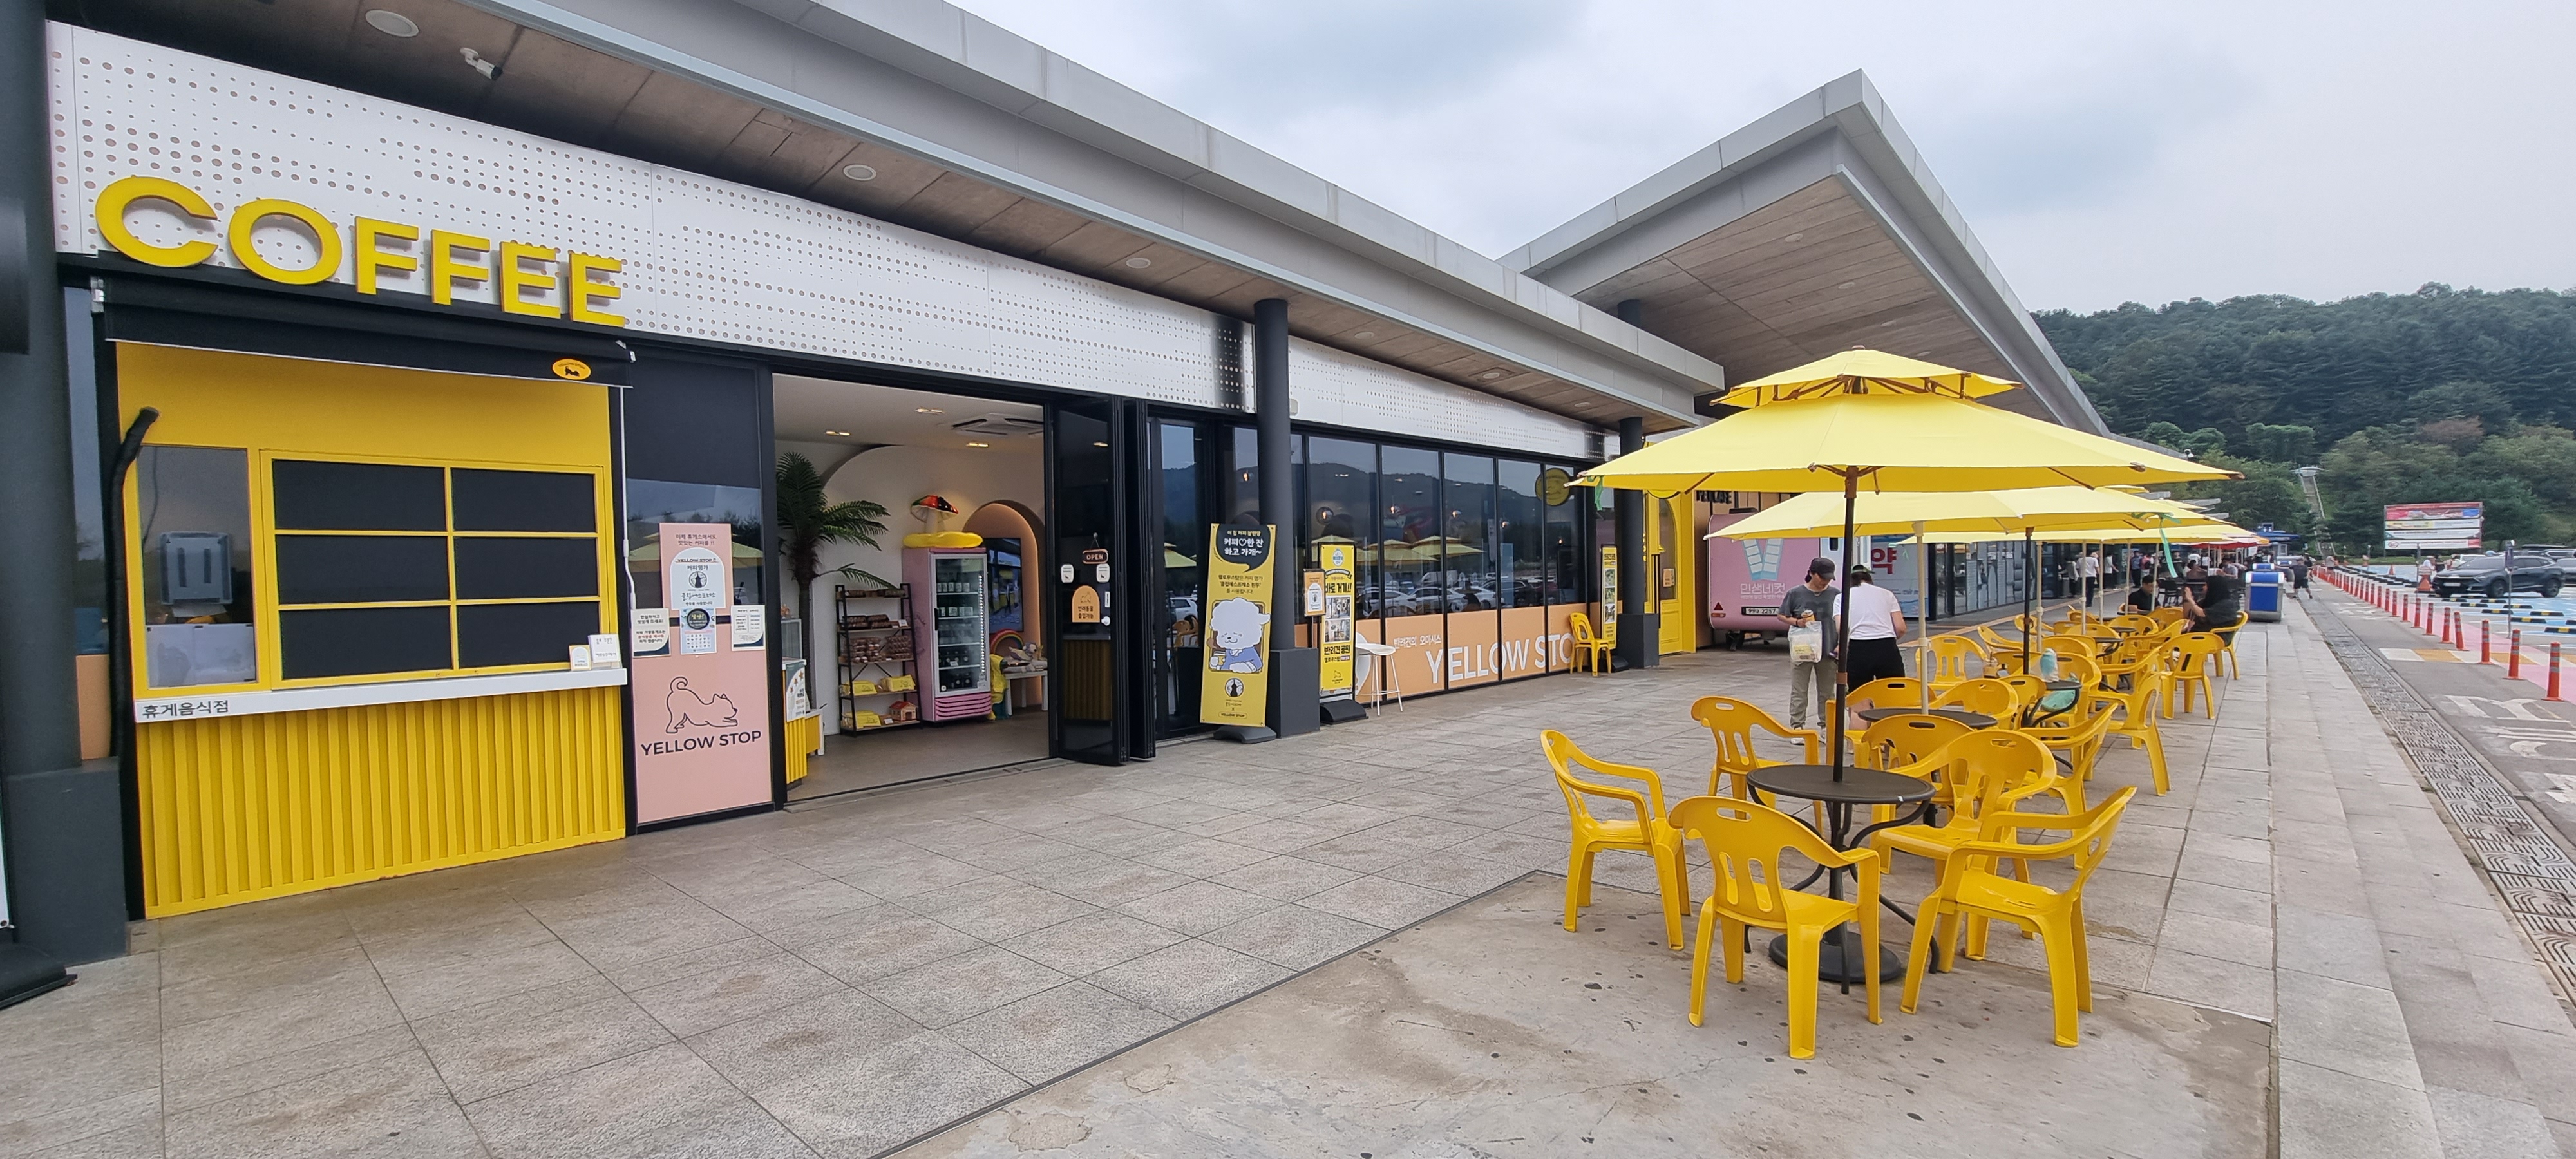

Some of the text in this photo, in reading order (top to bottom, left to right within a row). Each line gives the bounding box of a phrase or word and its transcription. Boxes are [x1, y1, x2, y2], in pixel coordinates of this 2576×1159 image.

[95, 176, 626, 327] COFFEE
[1256, 538, 1264, 547] 잔
[1871, 547, 1897, 574] 약
[1394, 636, 1417, 649] 반려견의
[1426, 638, 1530, 684] YELLOW
[1535, 632, 1575, 669] STO
[142, 700, 229, 719] 휴게음식점
[641, 730, 762, 756] YELLOW STOP
